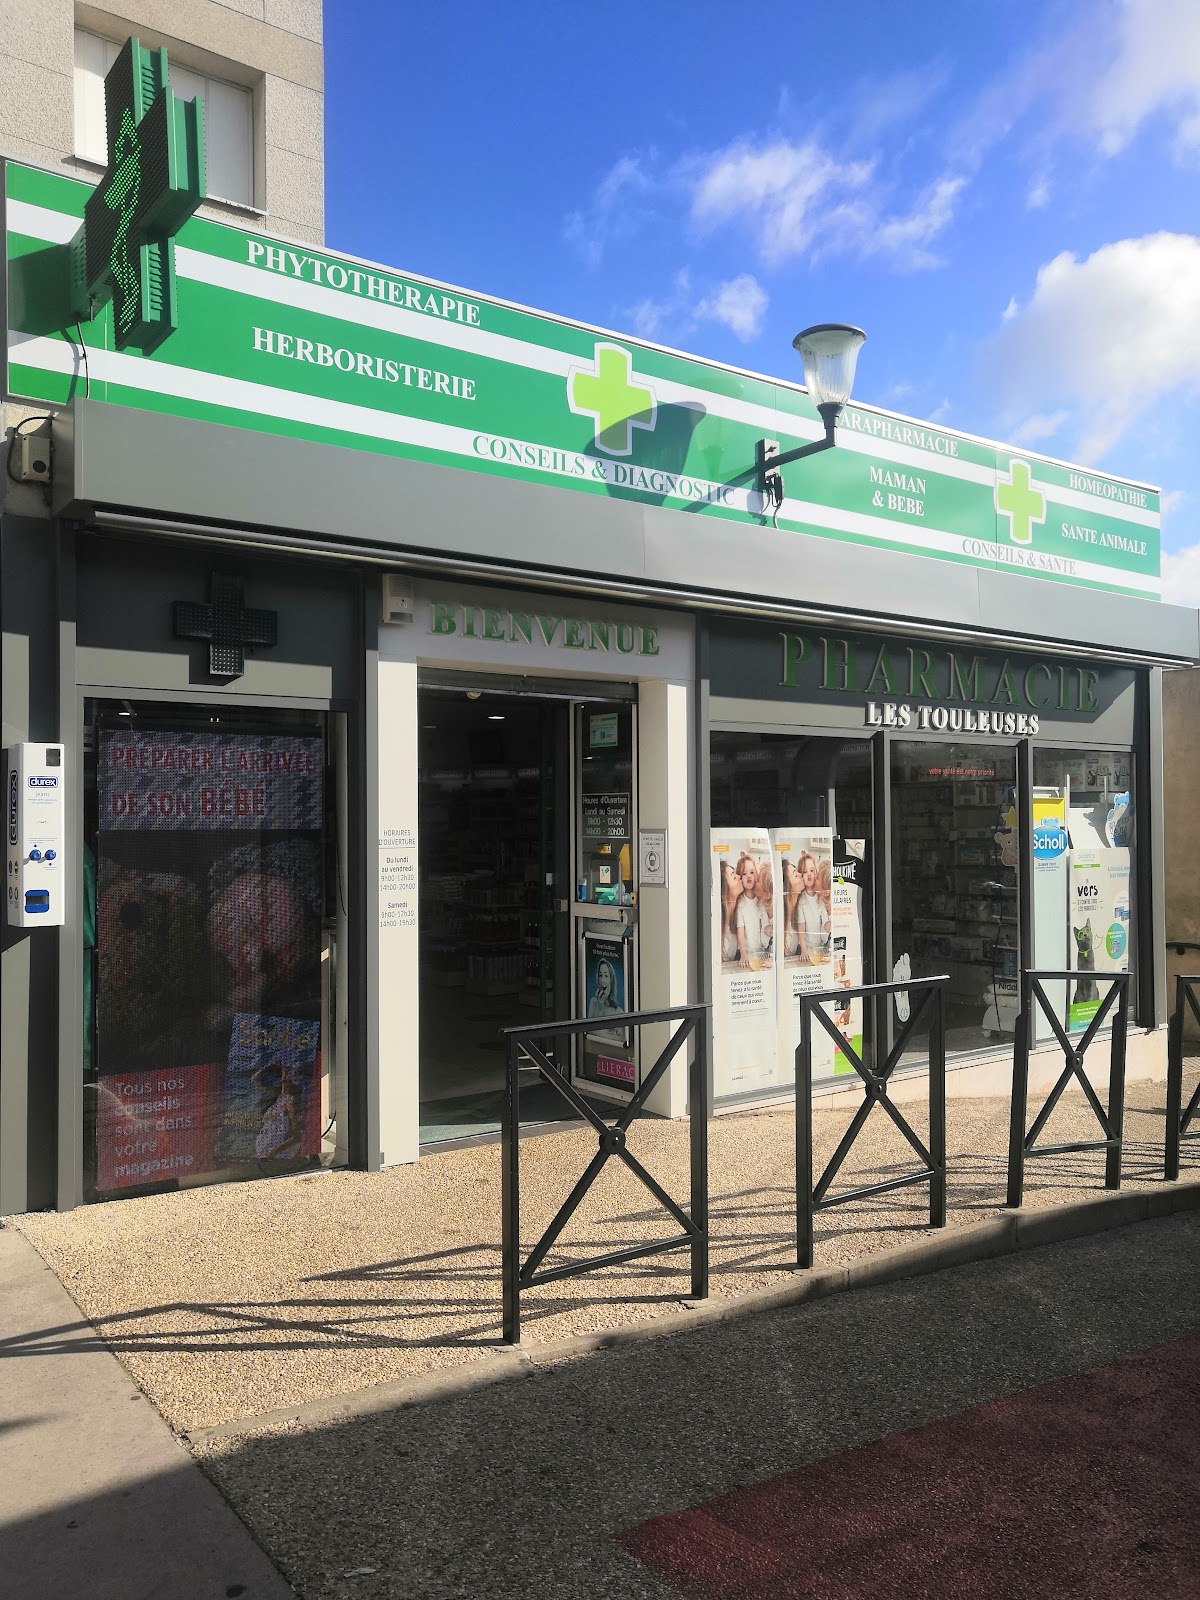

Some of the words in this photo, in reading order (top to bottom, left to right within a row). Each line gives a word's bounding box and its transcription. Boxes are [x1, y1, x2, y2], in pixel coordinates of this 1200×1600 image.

[246, 239, 481, 327] PHYTOTHERAPIE
[252, 326, 477, 401] HERBORISTERIE
[840, 411, 959, 457] ARAPHARMACIE
[472, 435, 585, 476] CONSEILS
[591, 460, 607, 480] &
[613, 463, 735, 506] DIAGNOSTIC
[869, 466, 926, 495] MAMAN
[1069, 473, 1147, 508] HOMEOPATHIE
[872, 490, 884, 508] &
[887, 492, 925, 517] BEBE
[1061, 522, 1098, 545] SANTE
[1099, 533, 1148, 556] ANIMALE
[962, 538, 1024, 565] CONSEILS
[1026, 551, 1036, 567] &
[1039, 554, 1076, 575] SANTE
[428, 601, 661, 656] BIENVENUE
[778, 631, 1101, 714] PHARMACIE
[866, 701, 912, 727] LES
[917, 704, 1040, 736] TOULEUSES
[31, 777, 57, 788] durex
[111, 793, 138, 816] DE
[147, 793, 190, 816] SON
[200, 779, 266, 817] BÉBÉ
[585, 807, 597, 815] Lundi
[607, 807, 626, 815] Samedi
[383, 829, 411, 837] HORAIRES
[1033, 833, 1065, 850] Scholl
[389, 865, 414, 873] vendredi
[1077, 885, 1098, 896] vers
[387, 901, 408, 909] Samedi
[601, 1060, 635, 1078] LIERAC
[115, 1082, 152, 1096] Tous
[157, 1079, 185, 1092] nos
[115, 1095, 181, 1117] conseils
[115, 1120, 151, 1137] sont
[156, 1116, 192, 1131] dans
[115, 1140, 157, 1157] votre
[114, 1154, 194, 1177] magazine
